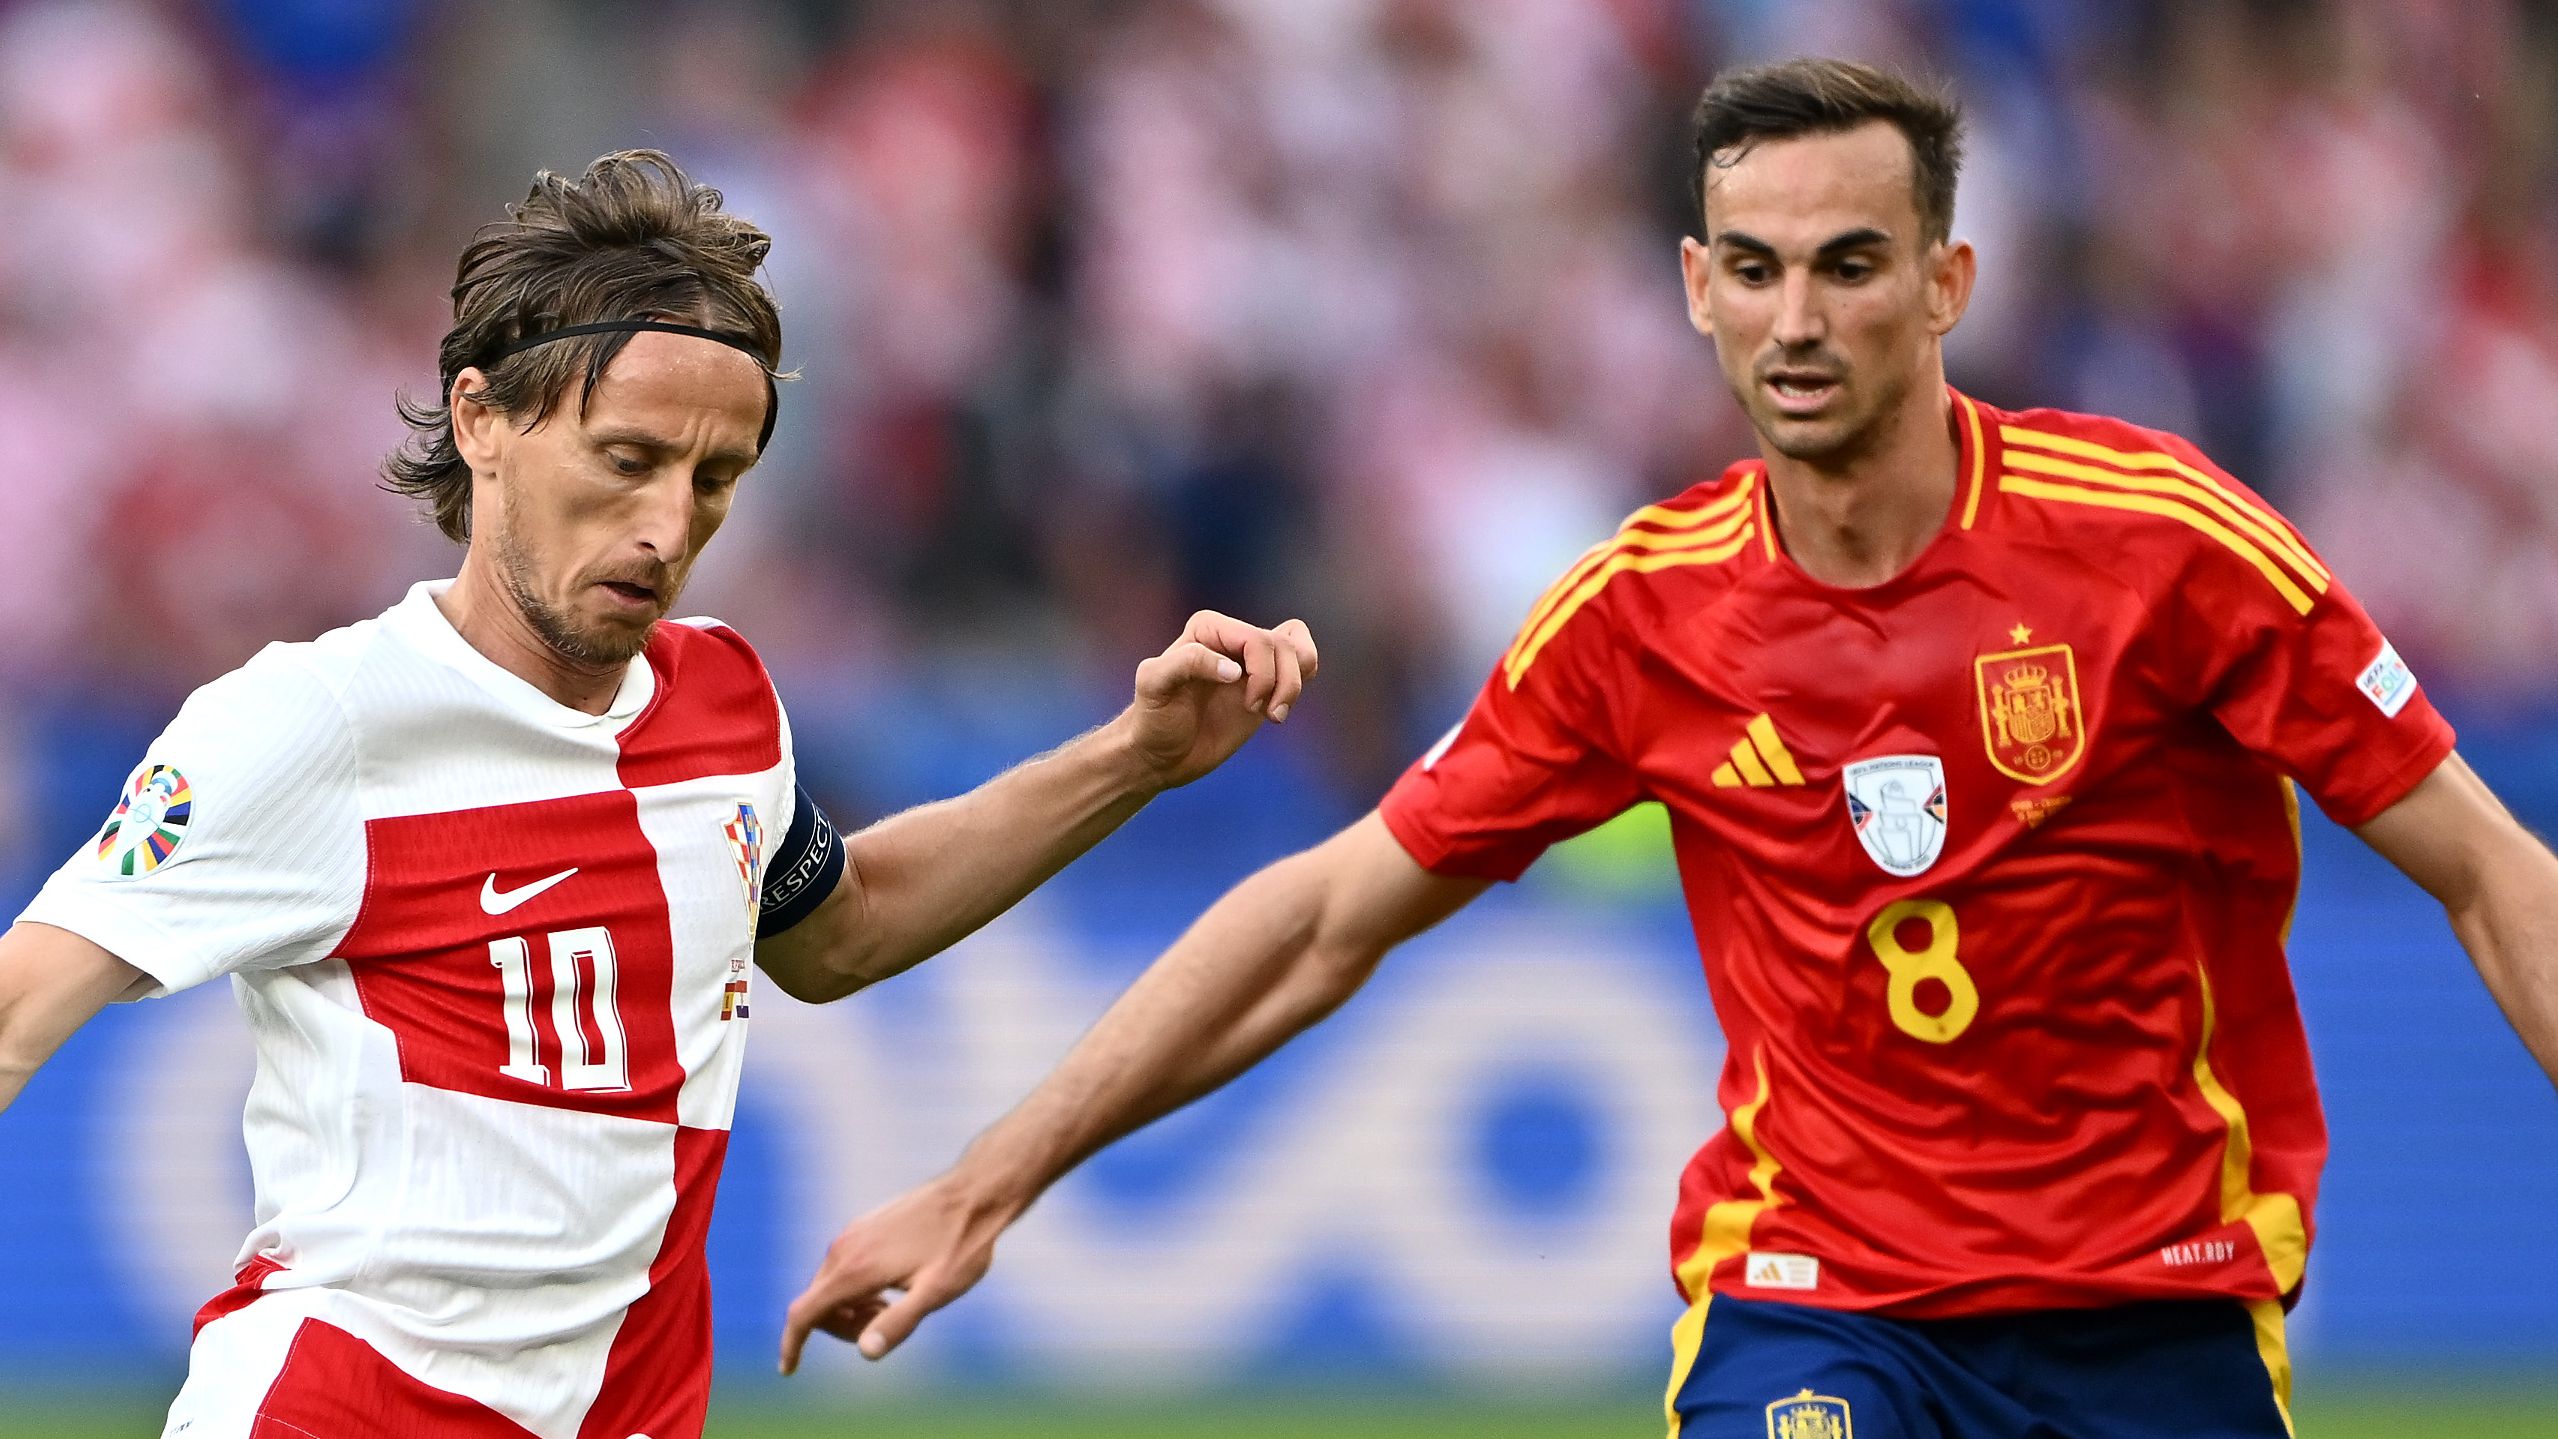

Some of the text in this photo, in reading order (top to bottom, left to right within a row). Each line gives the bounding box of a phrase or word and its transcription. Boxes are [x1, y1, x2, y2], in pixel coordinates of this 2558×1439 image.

[761, 808, 829, 910] RESPECT
[488, 926, 633, 1094] 10
[1867, 899, 1979, 1044] 8
[2161, 1240, 2234, 1266] HEAT.RDY
